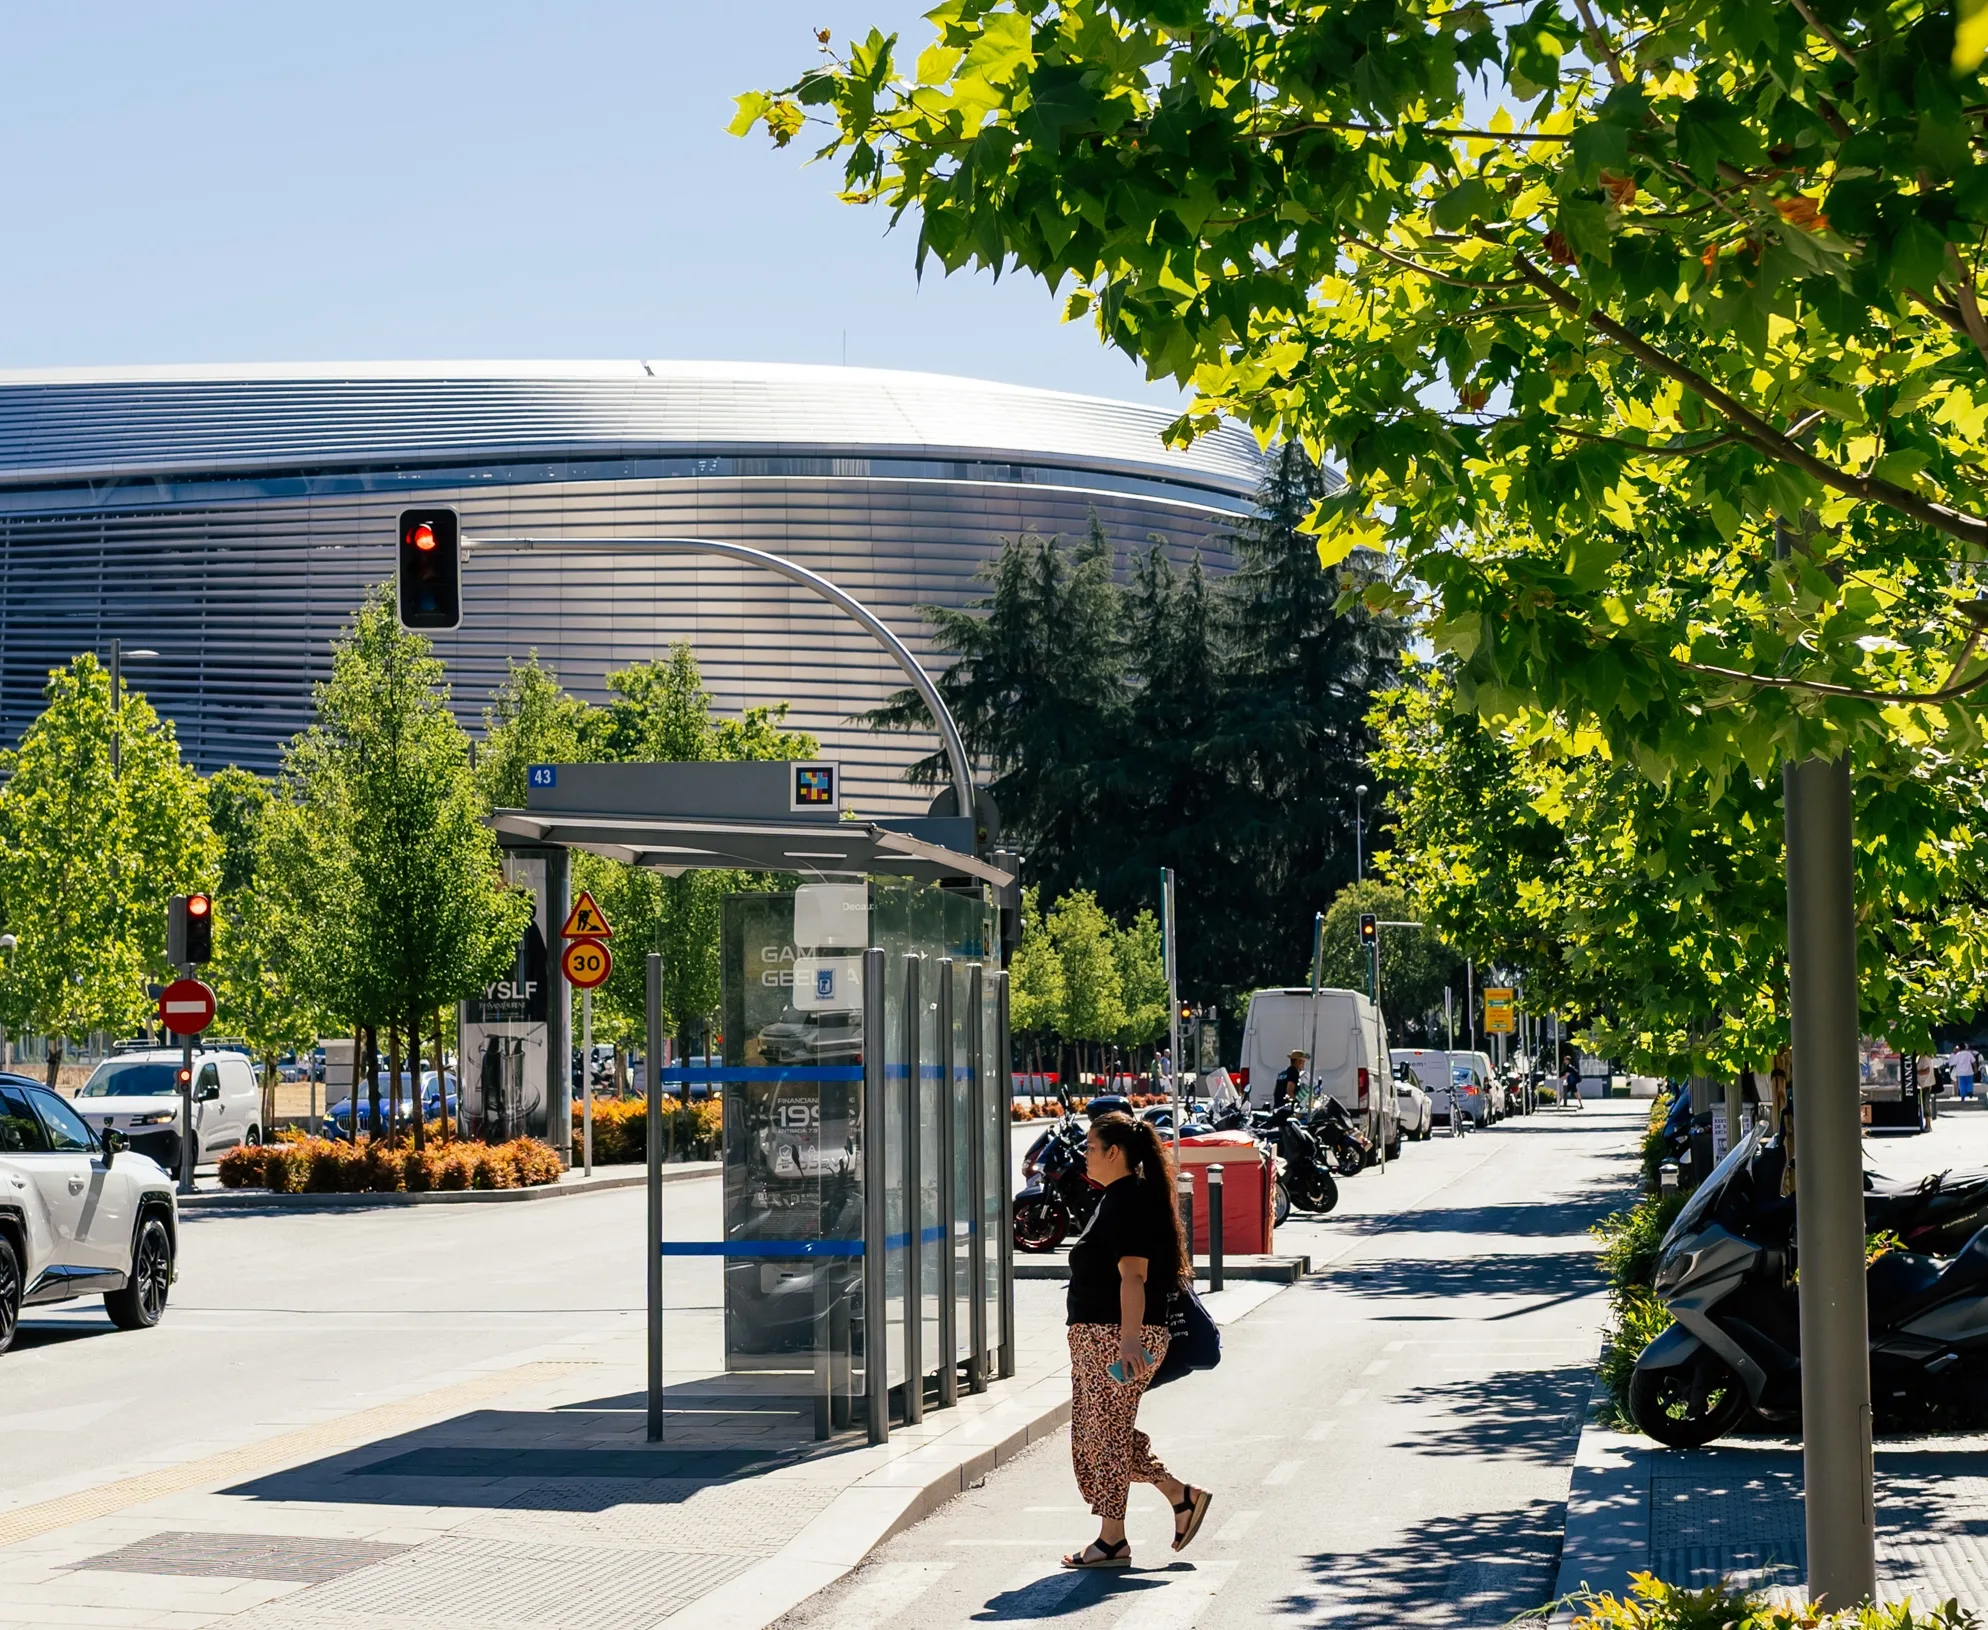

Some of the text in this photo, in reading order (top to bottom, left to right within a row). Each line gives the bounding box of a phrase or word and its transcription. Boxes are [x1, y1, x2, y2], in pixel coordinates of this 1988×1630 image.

[534, 770, 551, 784] 43
[573, 955, 601, 971] 30
[761, 969, 819, 987] GEEL
[484, 980, 538, 999] YSLF
